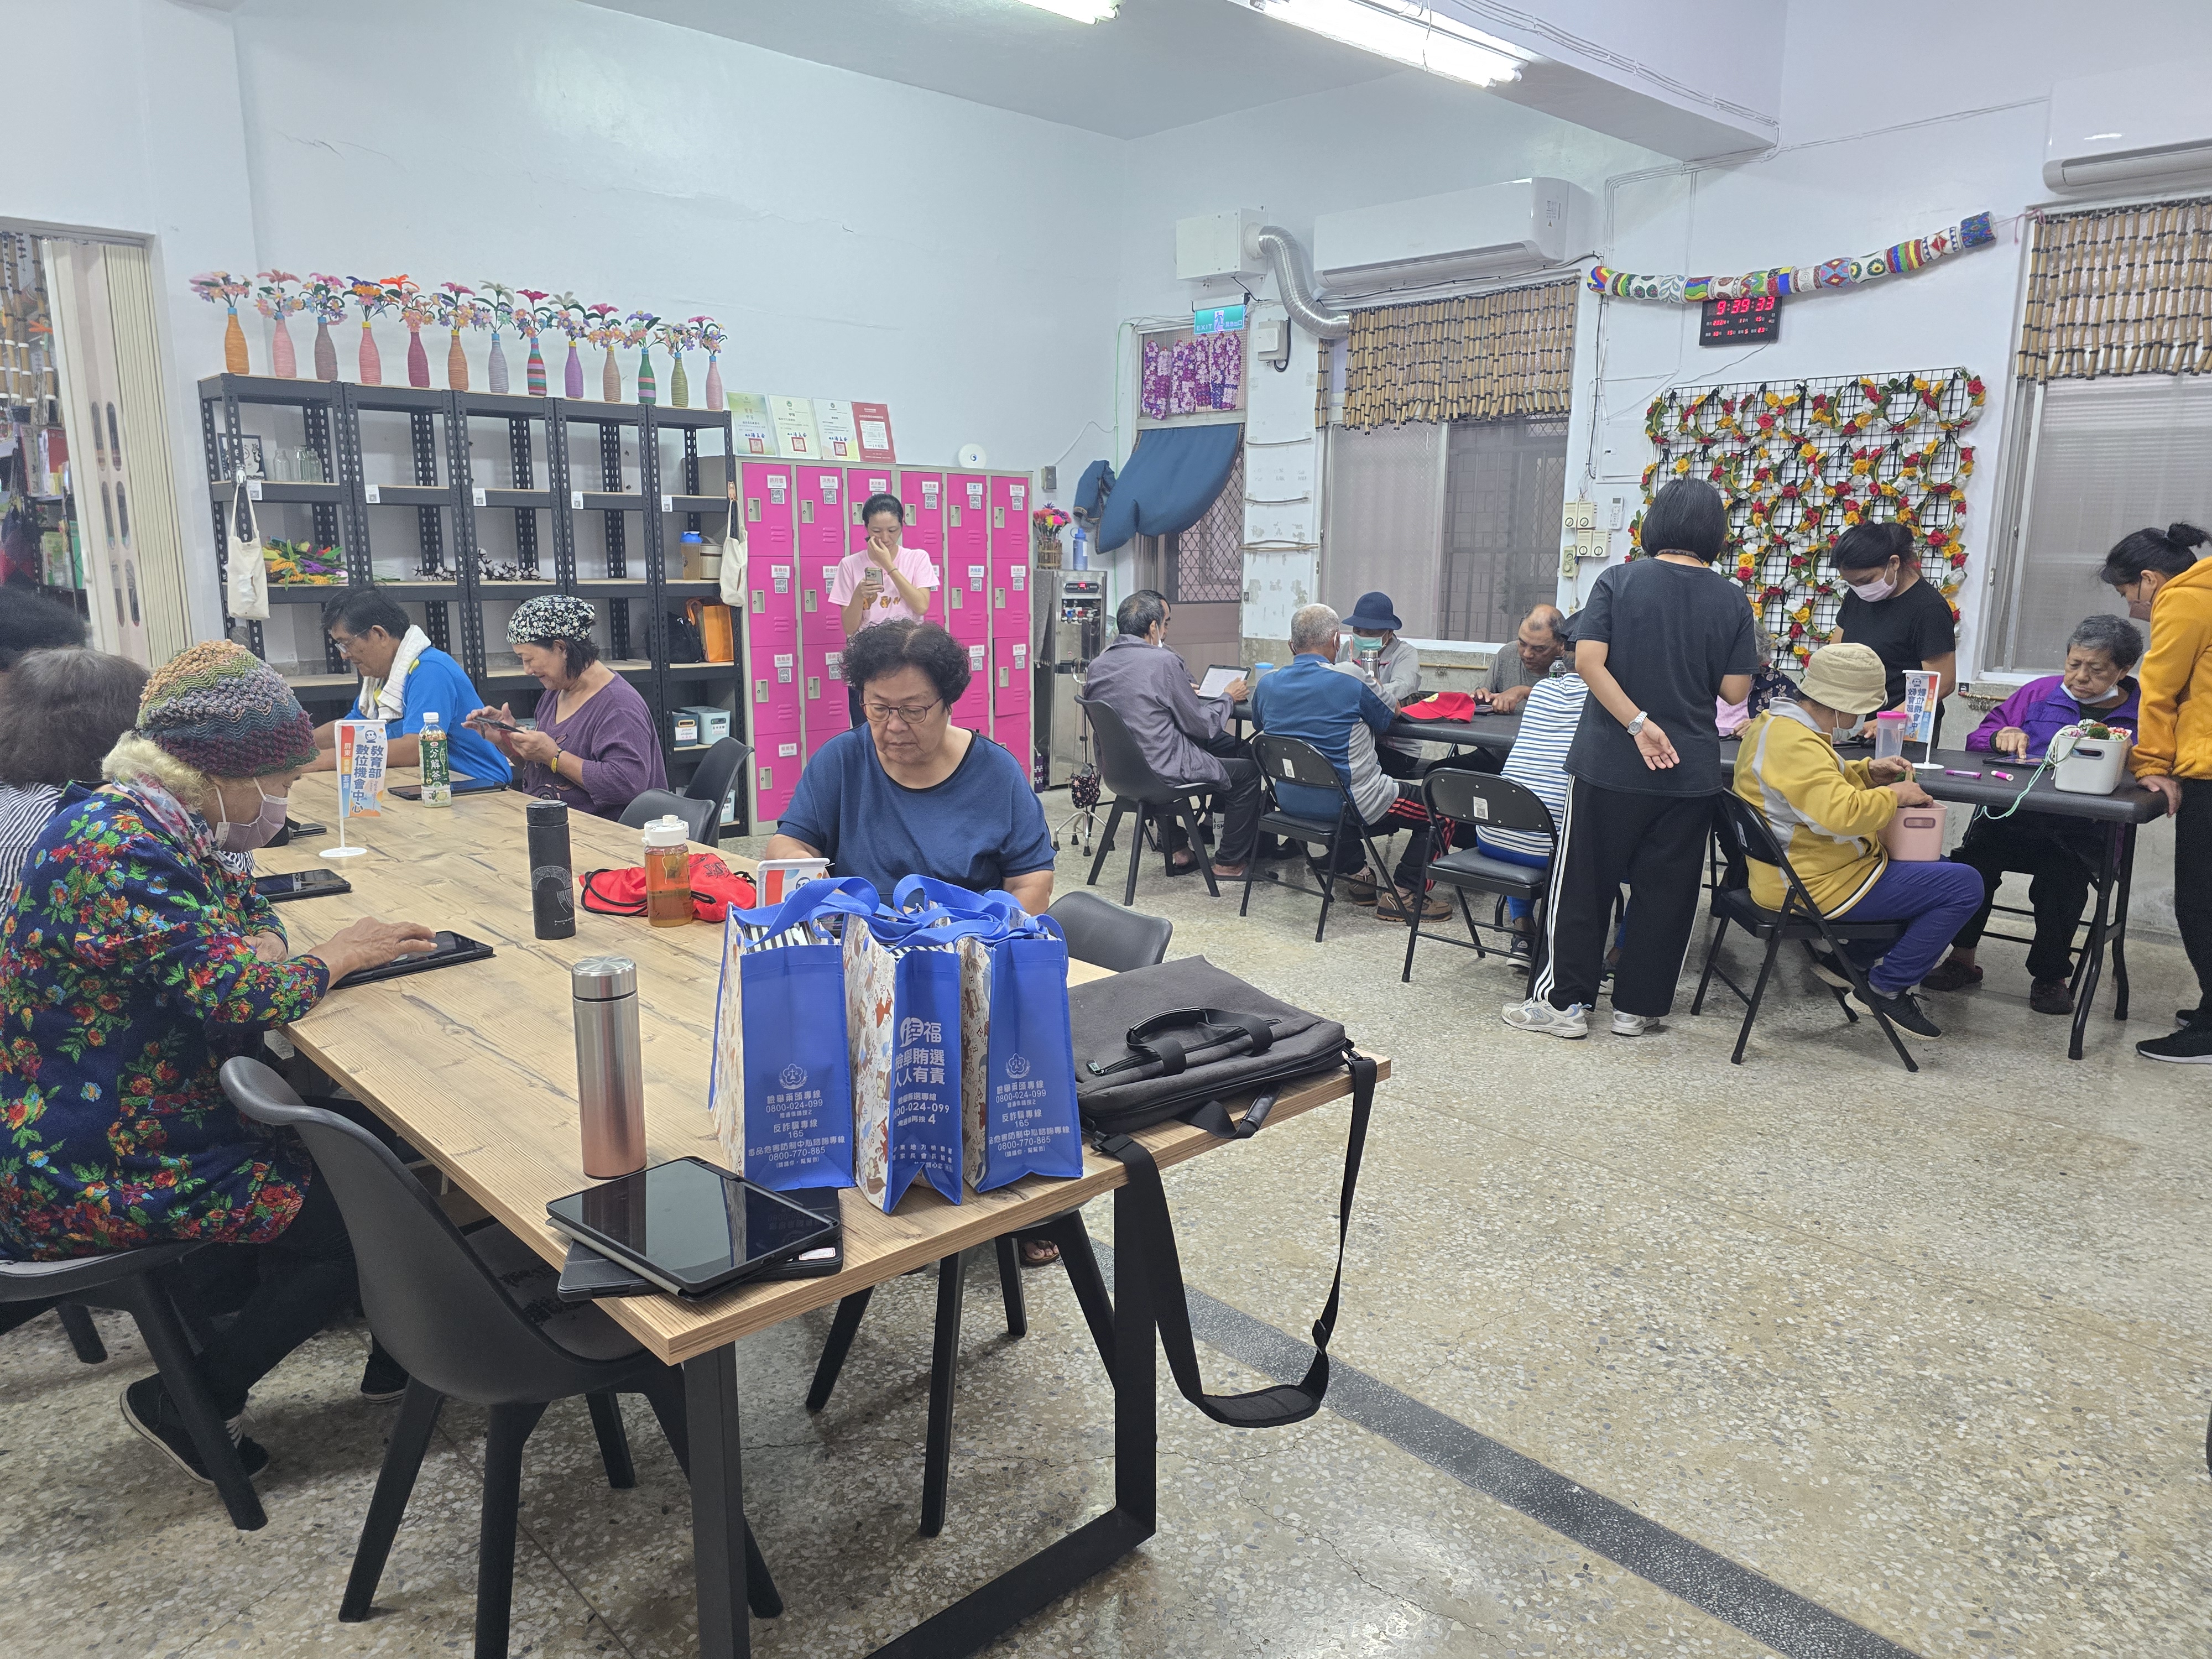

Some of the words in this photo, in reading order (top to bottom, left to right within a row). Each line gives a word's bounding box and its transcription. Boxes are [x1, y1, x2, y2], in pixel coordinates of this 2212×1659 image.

[1717, 296, 1775, 315] 9:39:33
[344, 743, 352, 757] 屏東
[368, 745, 384, 779] 教育部
[430, 749, 441, 780] 分解茶
[343, 775, 349, 789] 澎湖
[351, 744, 369, 813] 數位機會中心
[895, 1047, 945, 1072] 檢舉賄選
[894, 1066, 946, 1089] 人人有責
[997, 1079, 1044, 1095] 檢舉藥頭專線
[766, 1089, 821, 1104] 檢舉藥頭專線
[995, 1089, 1046, 1103] 0800-024-099
[765, 1099, 823, 1113] 0800-024-099
[928, 1114, 936, 1124] 4
[1002, 1108, 1042, 1123] 反詐騙專線
[773, 1119, 818, 1133] 反詐騙專線
[1014, 1119, 1029, 1128] 165
[788, 1130, 804, 1139] 165
[748, 1135, 845, 1157] 毒品危害防制中心諮詢專線
[998, 1136, 1051, 1151] 0800-770-885
[769, 1146, 826, 1161] 0800-770-885
